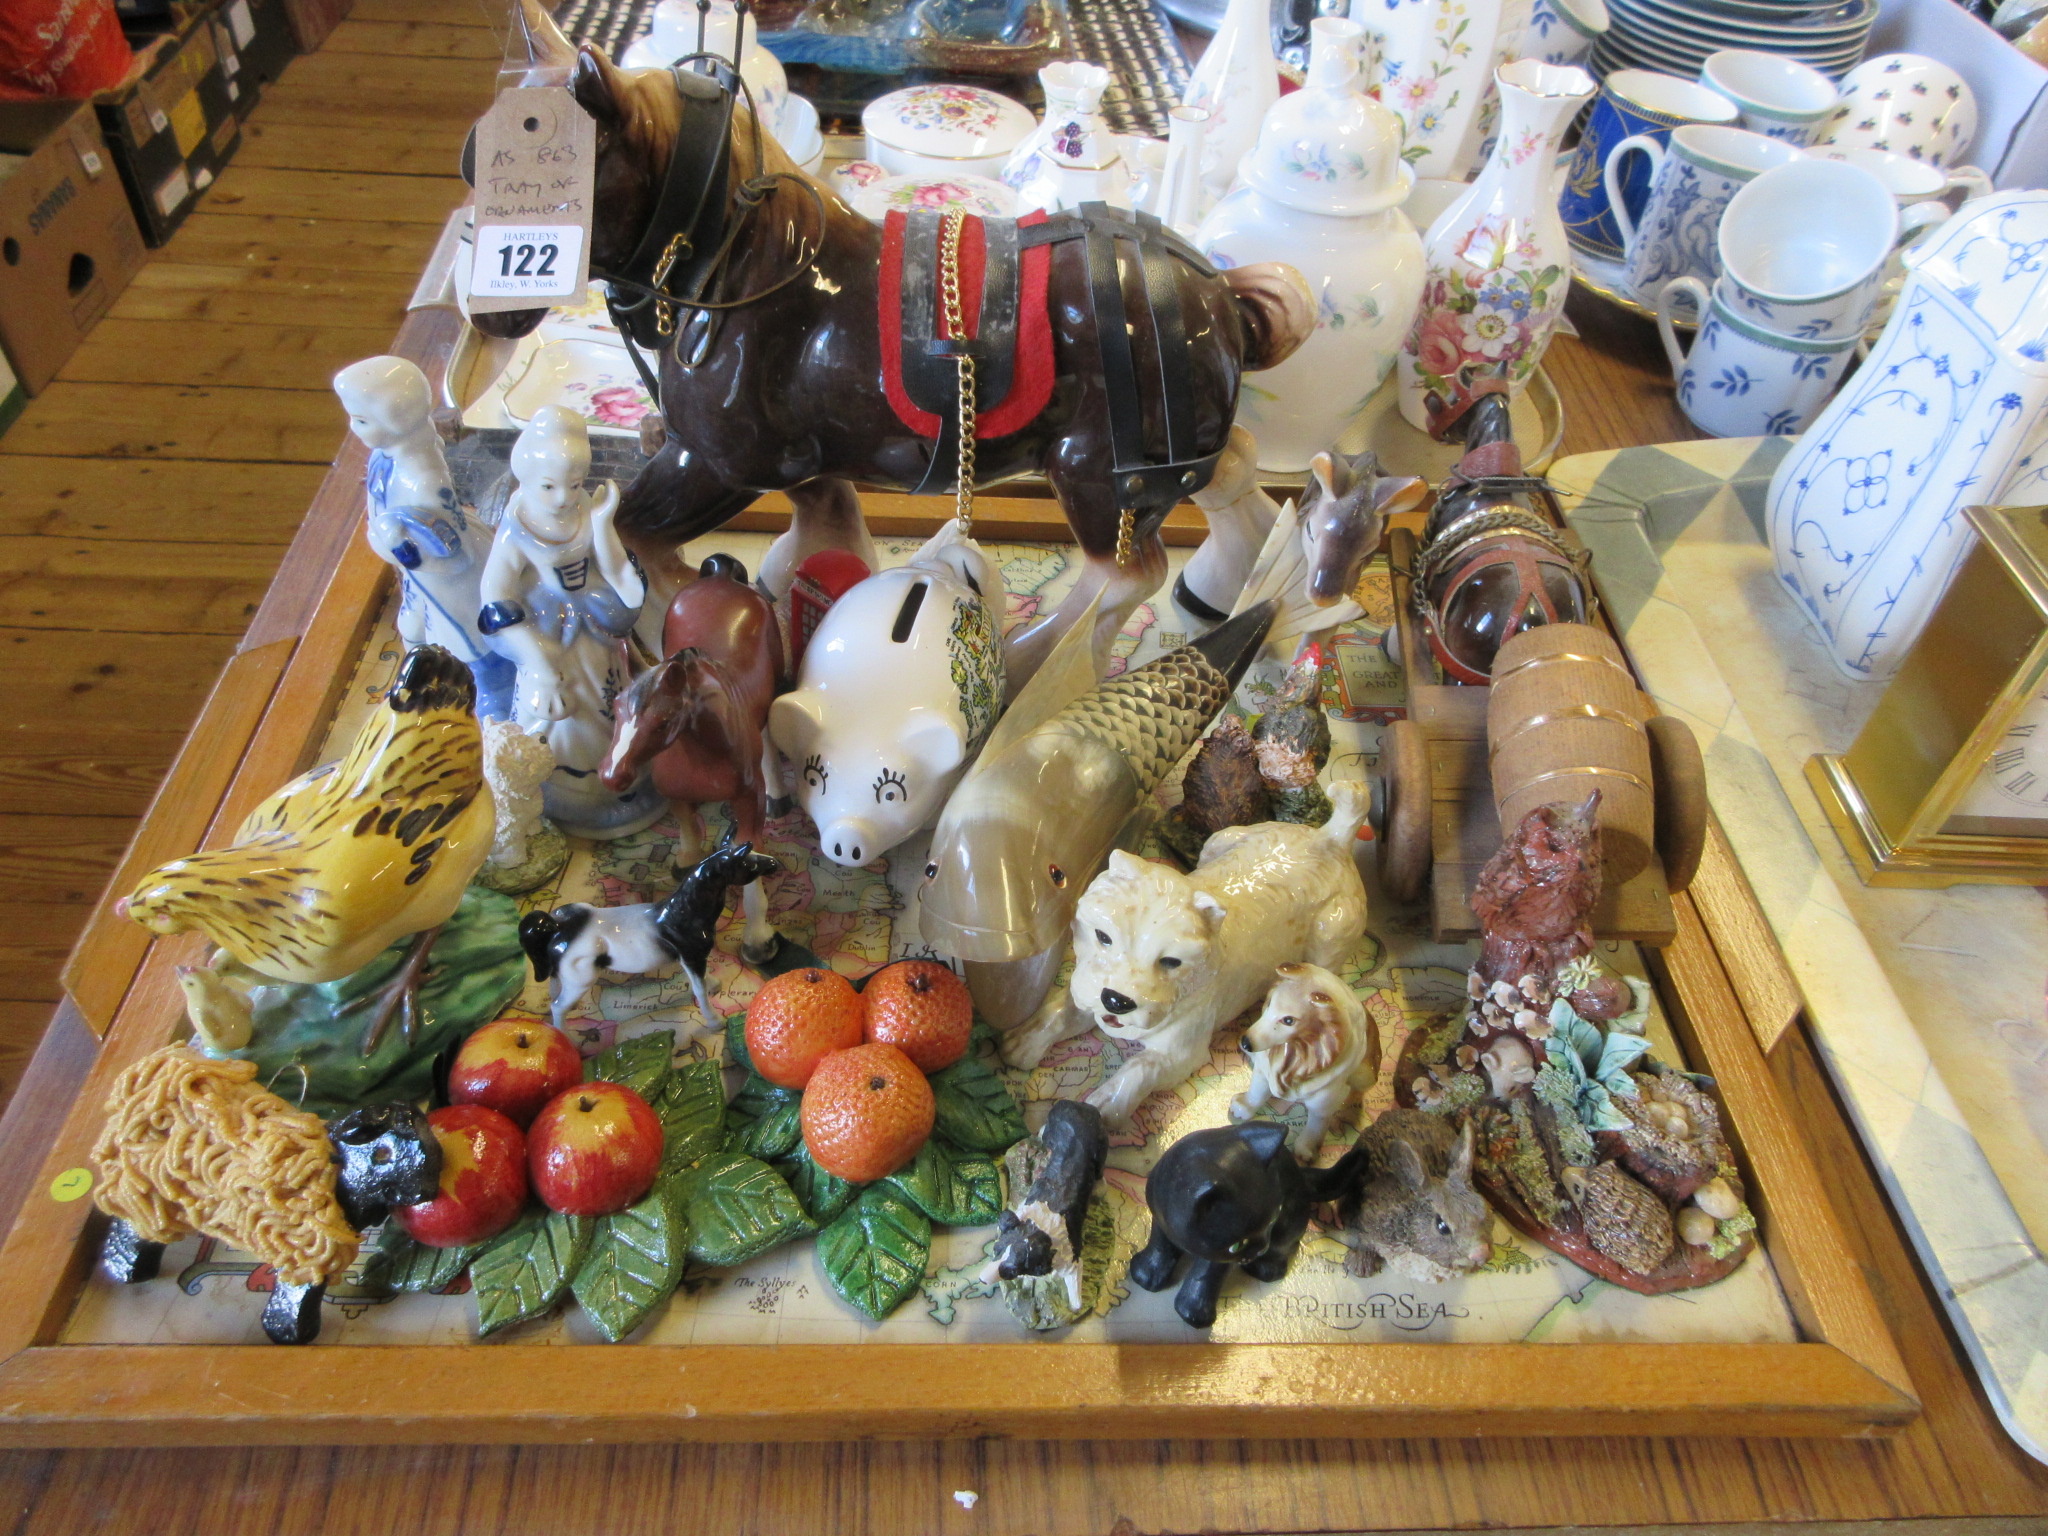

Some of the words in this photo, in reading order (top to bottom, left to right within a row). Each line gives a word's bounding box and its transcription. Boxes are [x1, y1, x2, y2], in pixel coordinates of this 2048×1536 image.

[503, 232, 559, 241] HARTLEYS
[498, 244, 559, 277] 122
[534, 279, 559, 289] Yorks
[1347, 654, 1377, 663] THE
[1353, 671, 1400, 680] GREAT
[1365, 680, 1397, 688] AND
[847, 943, 877, 952] Dublin
[613, 1001, 659, 1011] Limerick
[734, 1277, 755, 1288] The
